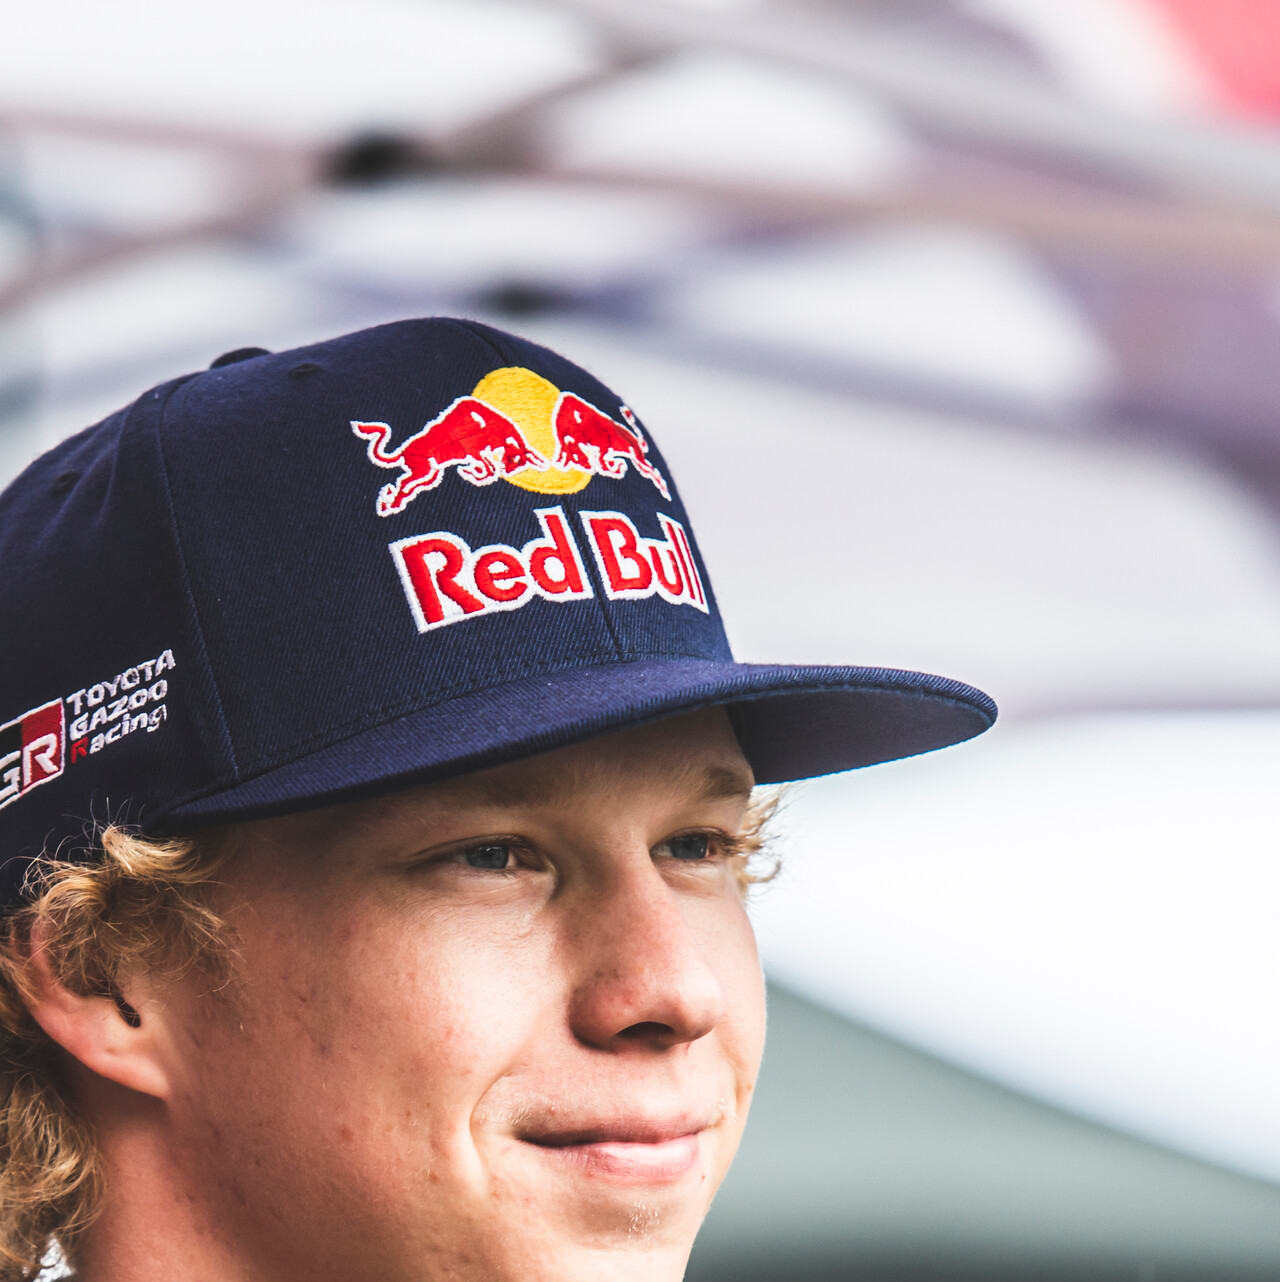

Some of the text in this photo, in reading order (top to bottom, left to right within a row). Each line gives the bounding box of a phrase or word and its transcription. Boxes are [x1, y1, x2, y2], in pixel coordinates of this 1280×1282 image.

[391, 507, 709, 630] Red Bull
[66, 648, 176, 715] TOYOTA
[70, 679, 168, 741] GAZOO
[71, 703, 168, 764] Racing
